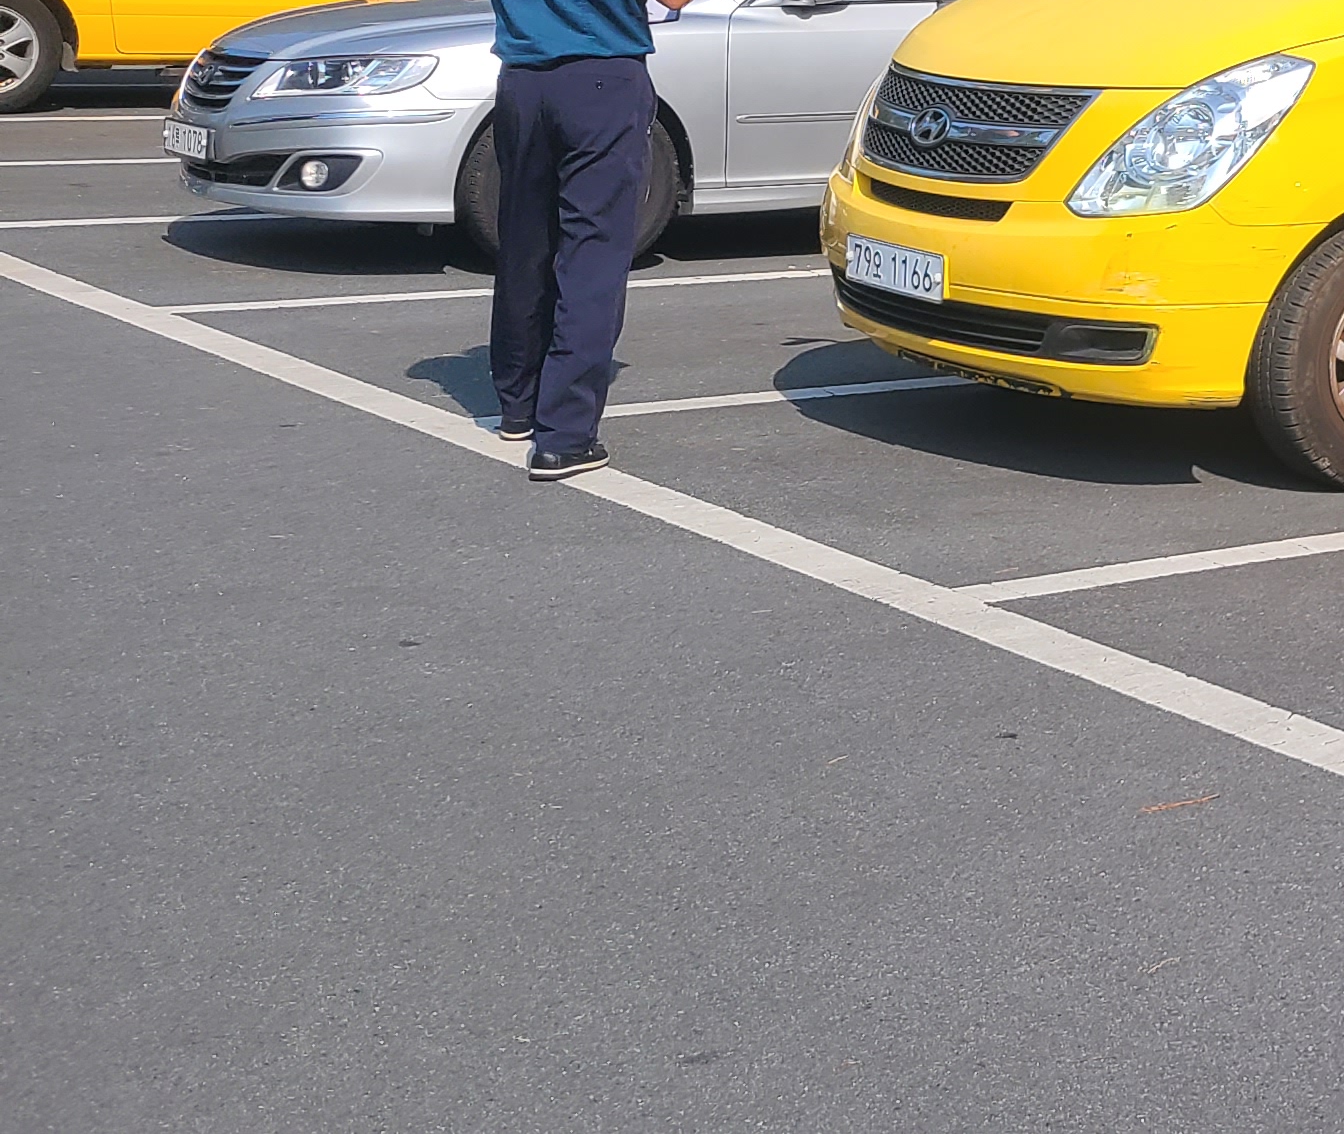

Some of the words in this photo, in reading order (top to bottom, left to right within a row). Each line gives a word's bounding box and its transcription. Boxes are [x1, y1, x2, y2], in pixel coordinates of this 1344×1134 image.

[182, 128, 203, 154] 1078
[854, 242, 882, 279] 79오
[891, 252, 933, 293] 1166
